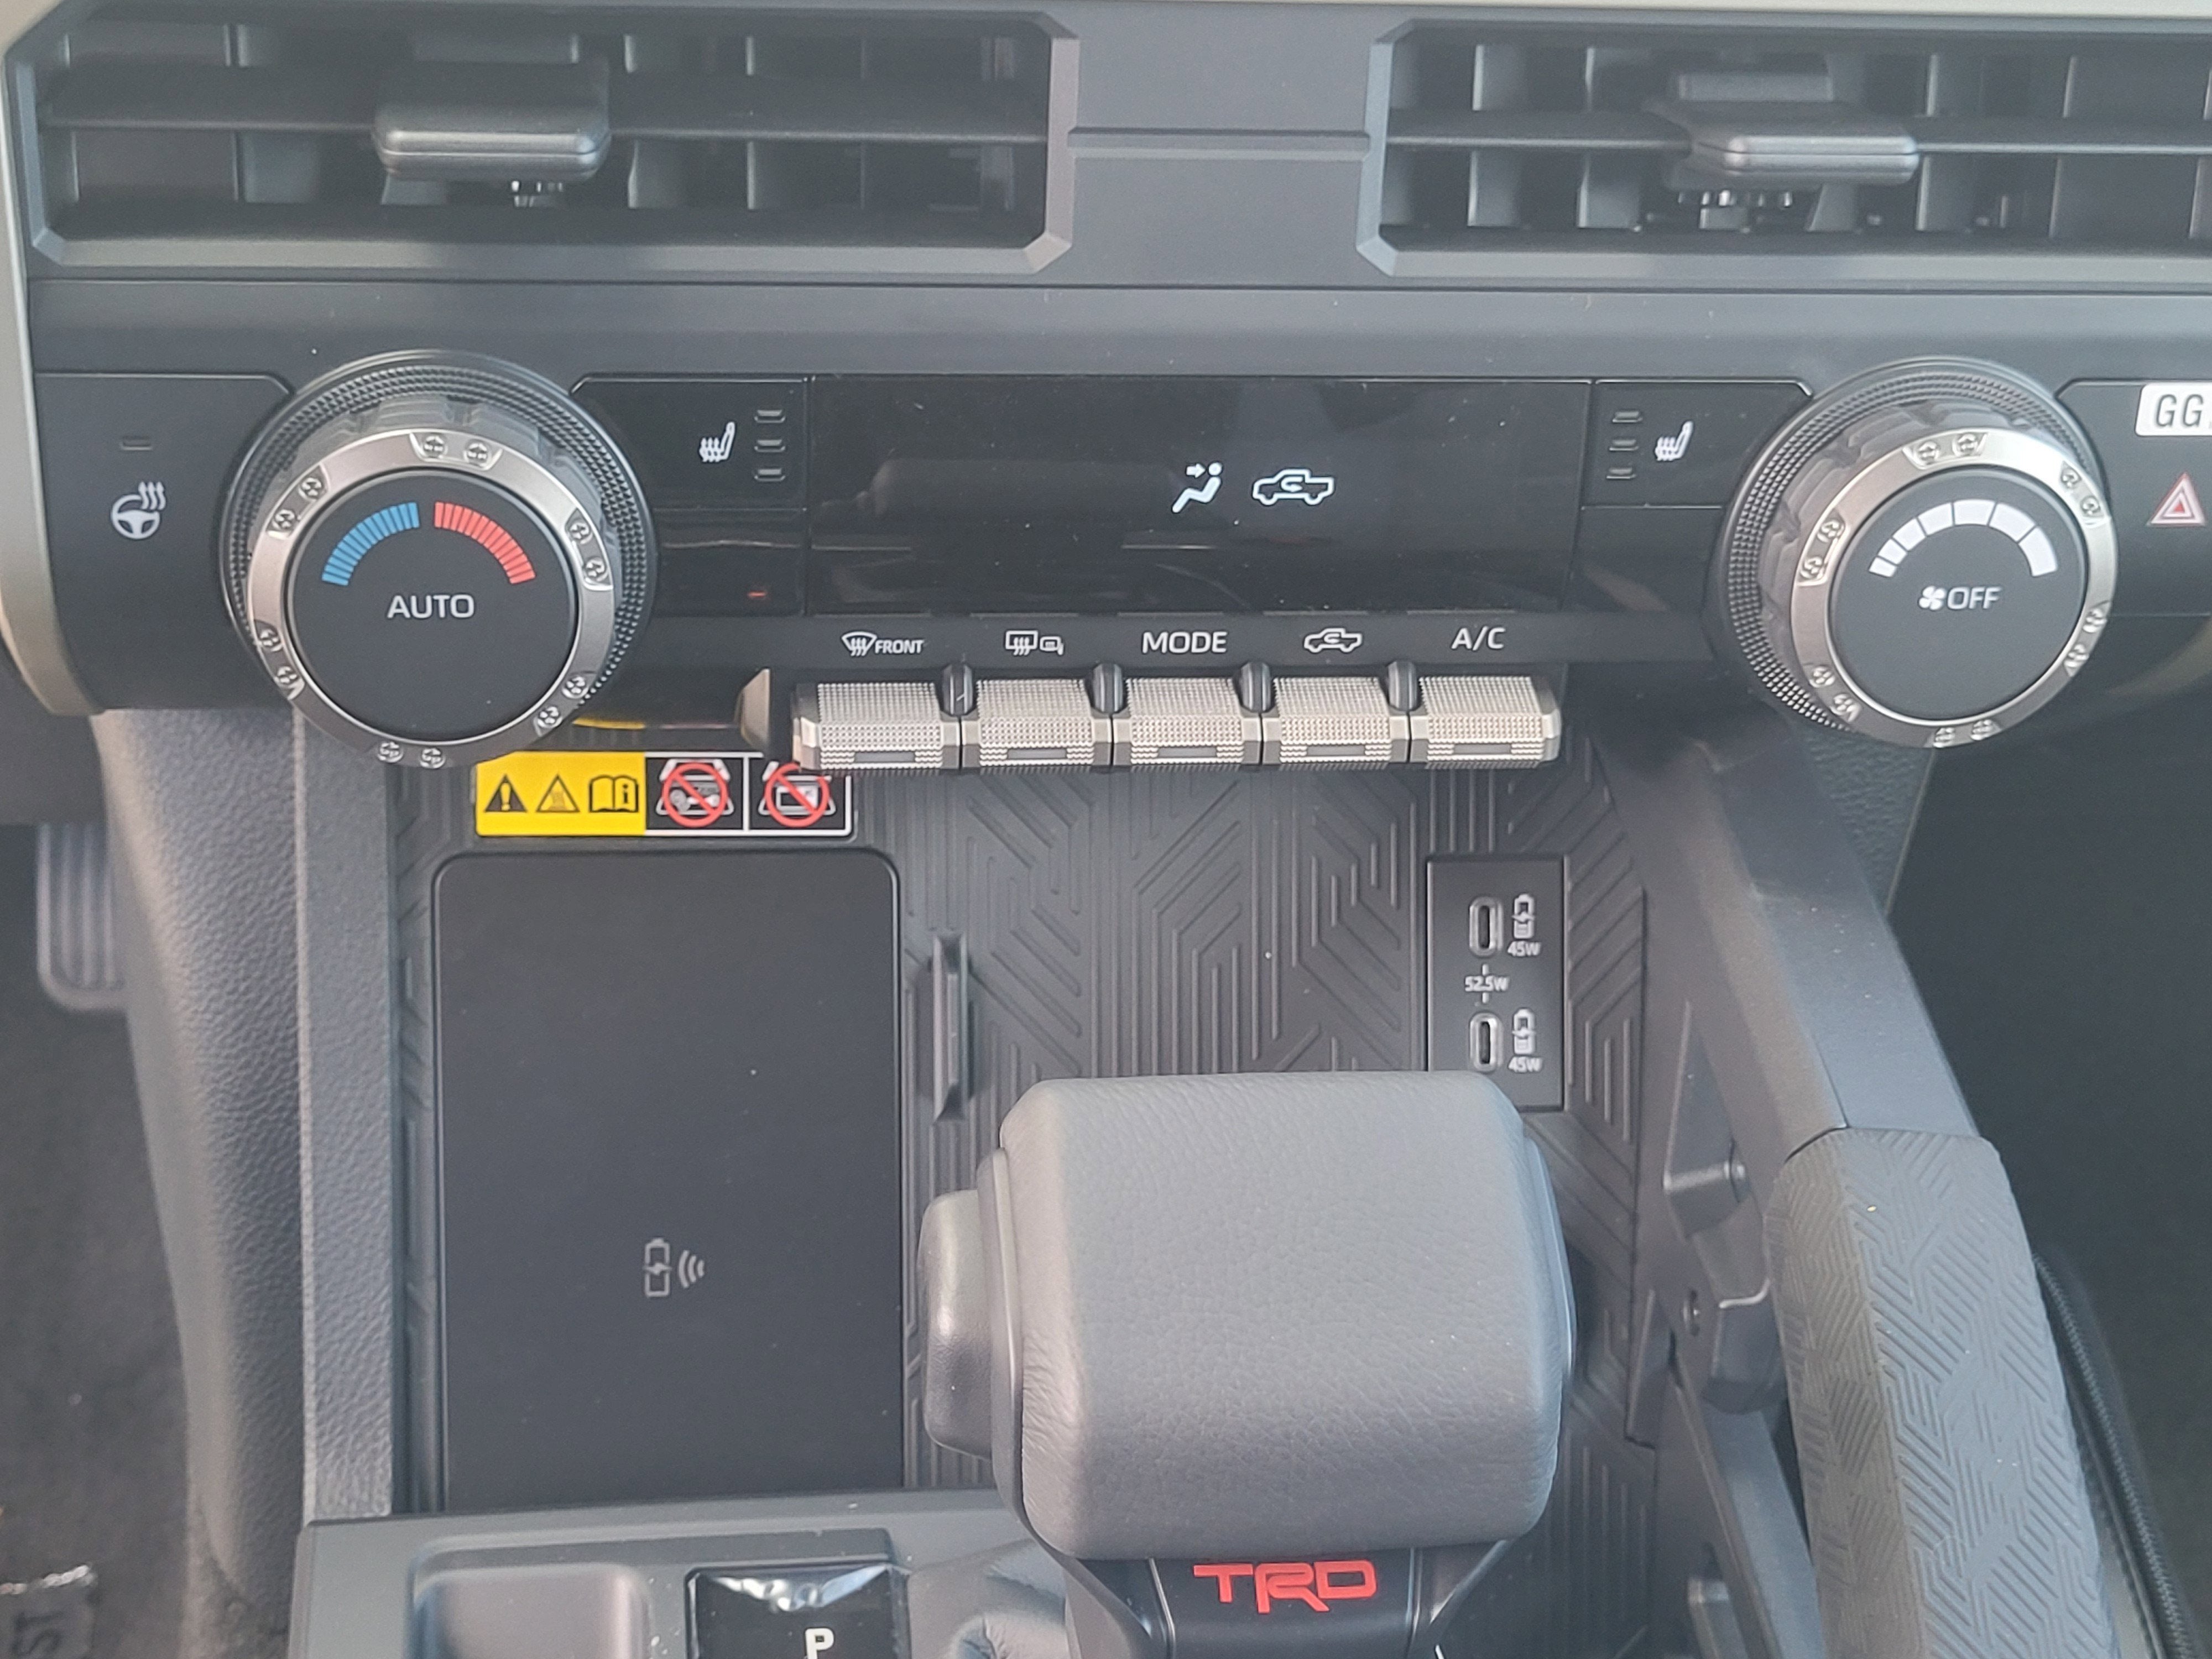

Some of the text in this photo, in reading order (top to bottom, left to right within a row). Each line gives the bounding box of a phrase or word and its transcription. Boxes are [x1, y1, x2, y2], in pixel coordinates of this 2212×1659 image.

[387, 594, 474, 618] AUTO
[1947, 587, 2002, 609] OFF
[874, 639, 925, 654] FRONT
[1142, 631, 1228, 654] MODE
[1451, 626, 1506, 651] A/C
[1507, 941, 1541, 957] 45W
[1507, 1056, 1542, 1072] 45W
[1193, 1559, 1378, 1614] TRD
[805, 1628, 834, 1659] P
